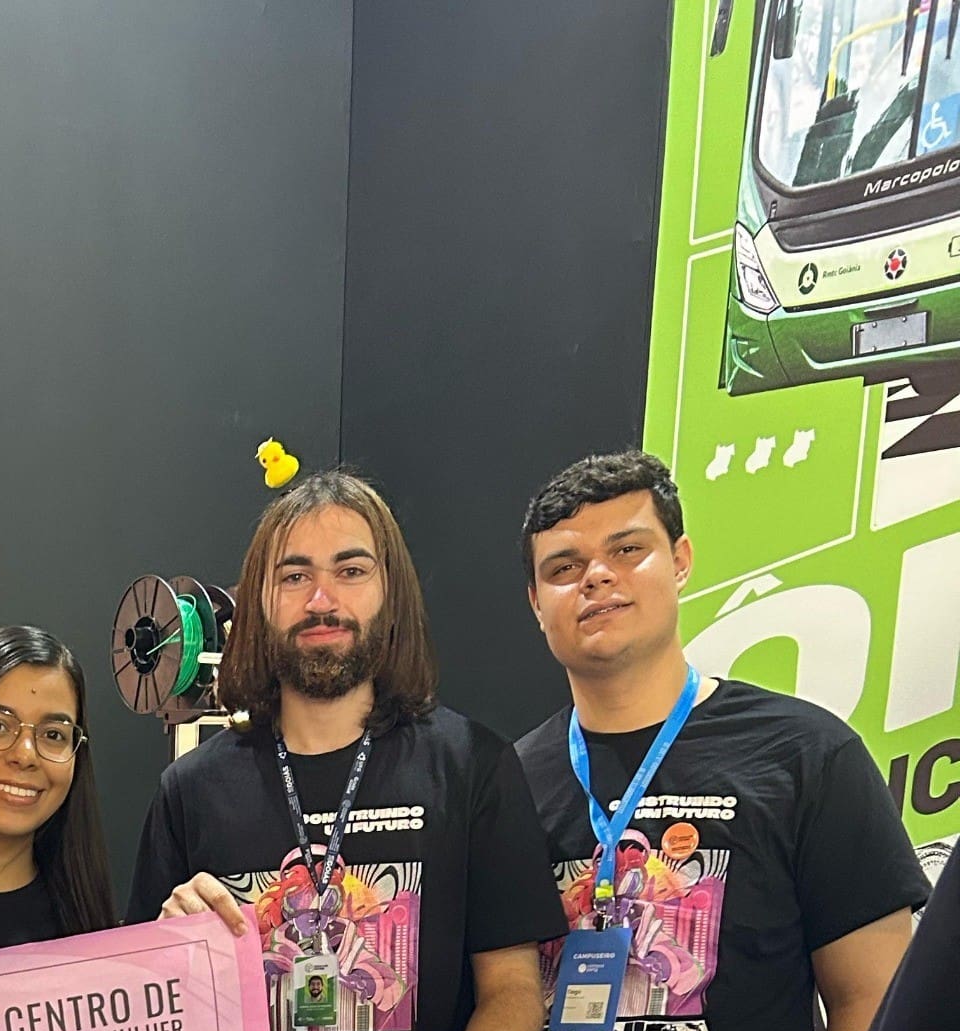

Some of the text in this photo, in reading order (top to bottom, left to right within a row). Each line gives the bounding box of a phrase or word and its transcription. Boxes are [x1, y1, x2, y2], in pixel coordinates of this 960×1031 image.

[863, 159, 960, 197] Marcopolo
[662, 807, 736, 820] FUTURO
[352, 818, 424, 833] FUTURO
[573, 952, 616, 960] CAMPUSEIRO
[144, 978, 184, 1019] DE
